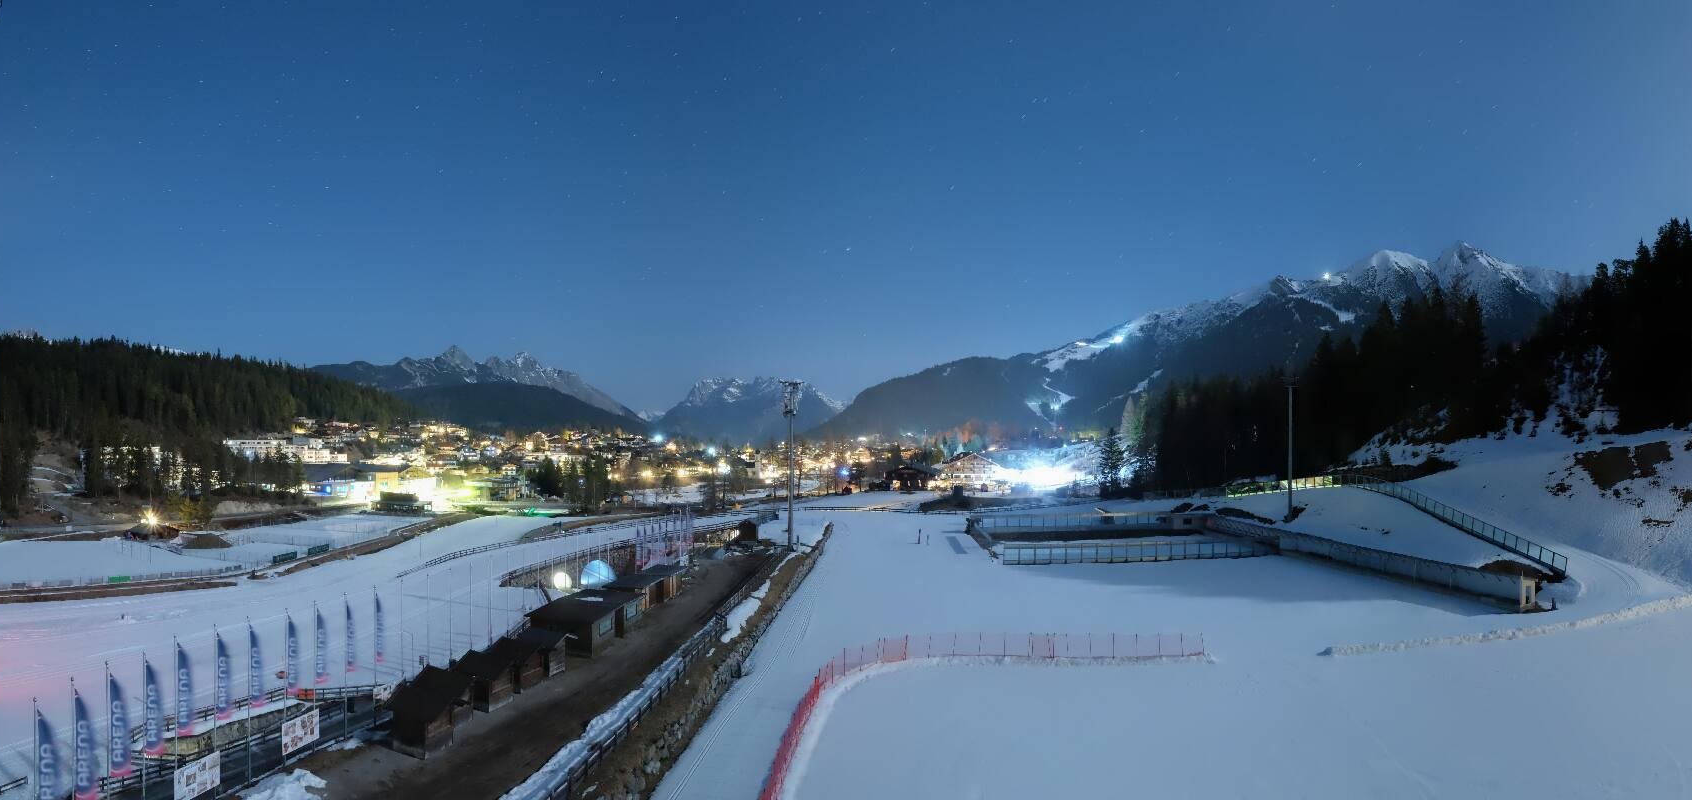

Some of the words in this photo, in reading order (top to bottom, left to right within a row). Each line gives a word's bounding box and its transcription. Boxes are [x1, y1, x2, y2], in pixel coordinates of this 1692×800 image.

[147, 684, 158, 742] ARENA
[179, 668, 190, 723] ARENA
[78, 720, 91, 787] ARENA
[112, 701, 125, 763] ARENA
[40, 744, 55, 800] RENA
